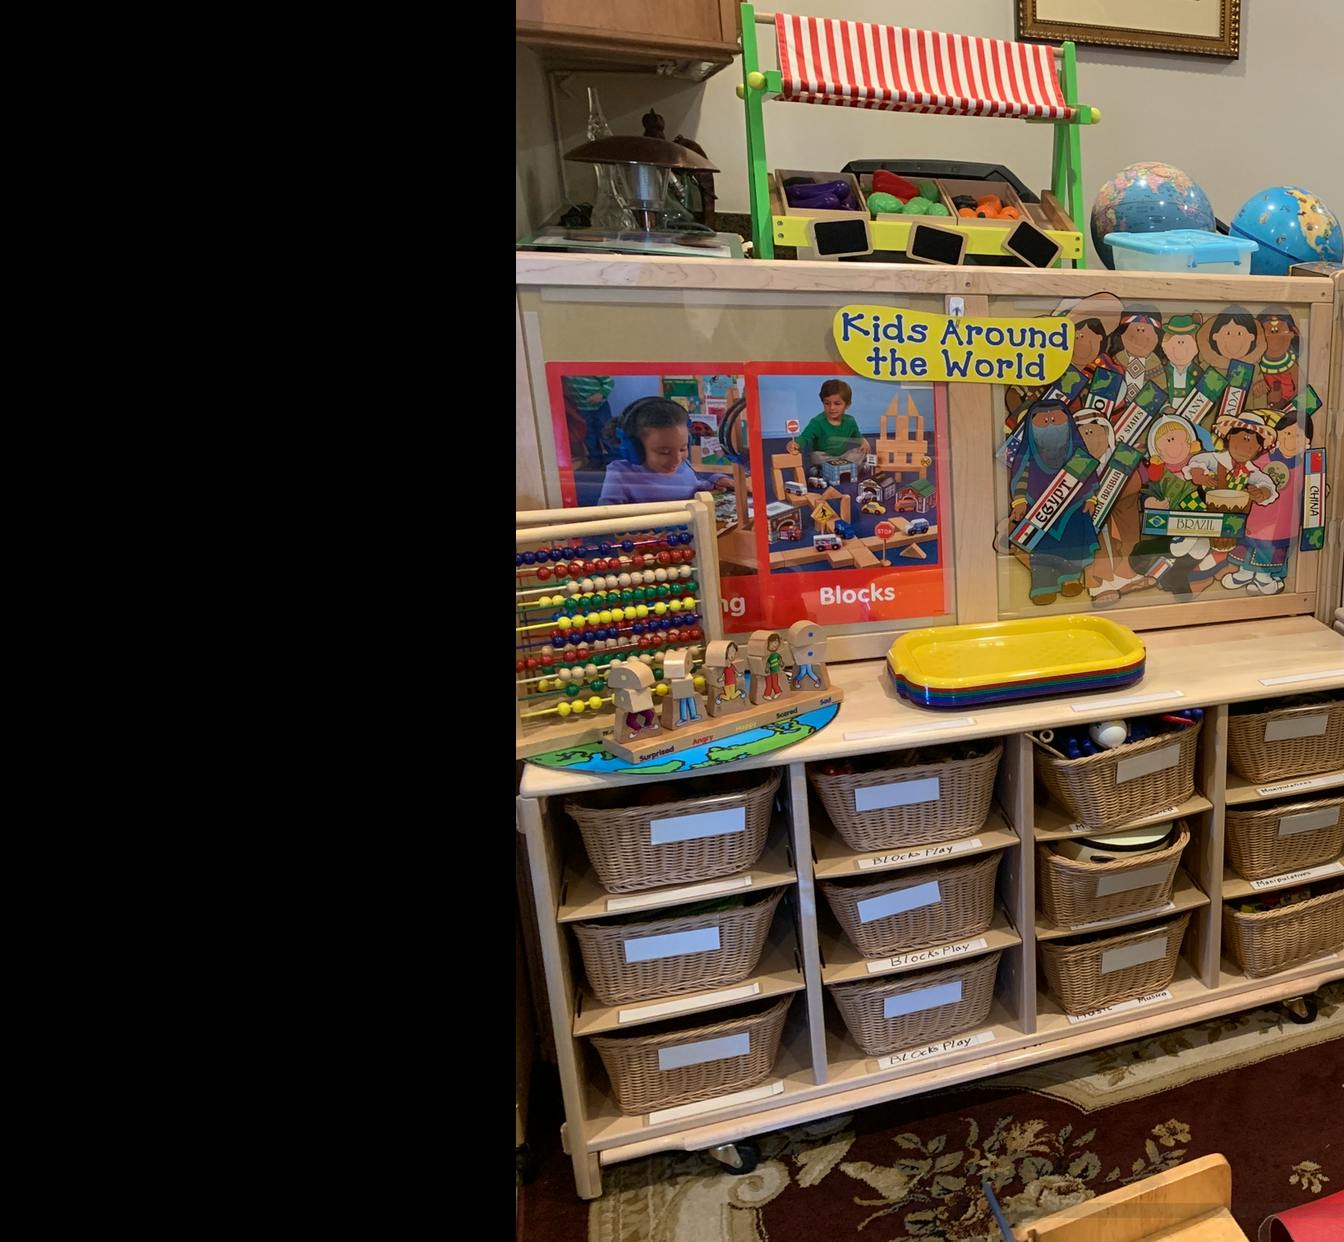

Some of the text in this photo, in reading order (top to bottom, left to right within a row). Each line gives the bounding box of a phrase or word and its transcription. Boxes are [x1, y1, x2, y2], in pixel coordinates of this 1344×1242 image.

[842, 312, 1069, 350] Kids Around
[866, 347, 1046, 380] the World
[1124, 411, 1144, 433] STATES
[1036, 479, 1072, 523] EGYPT
[1310, 485, 1320, 517] CHINA
[1176, 518, 1216, 531] BRAZIL
[819, 583, 896, 605] Blocks
[776, 707, 798, 719] Scared
[640, 744, 675, 761] Surprised
[925, 846, 953, 856] Play
[943, 943, 970, 956] Play
[943, 1037, 972, 1051] Play
